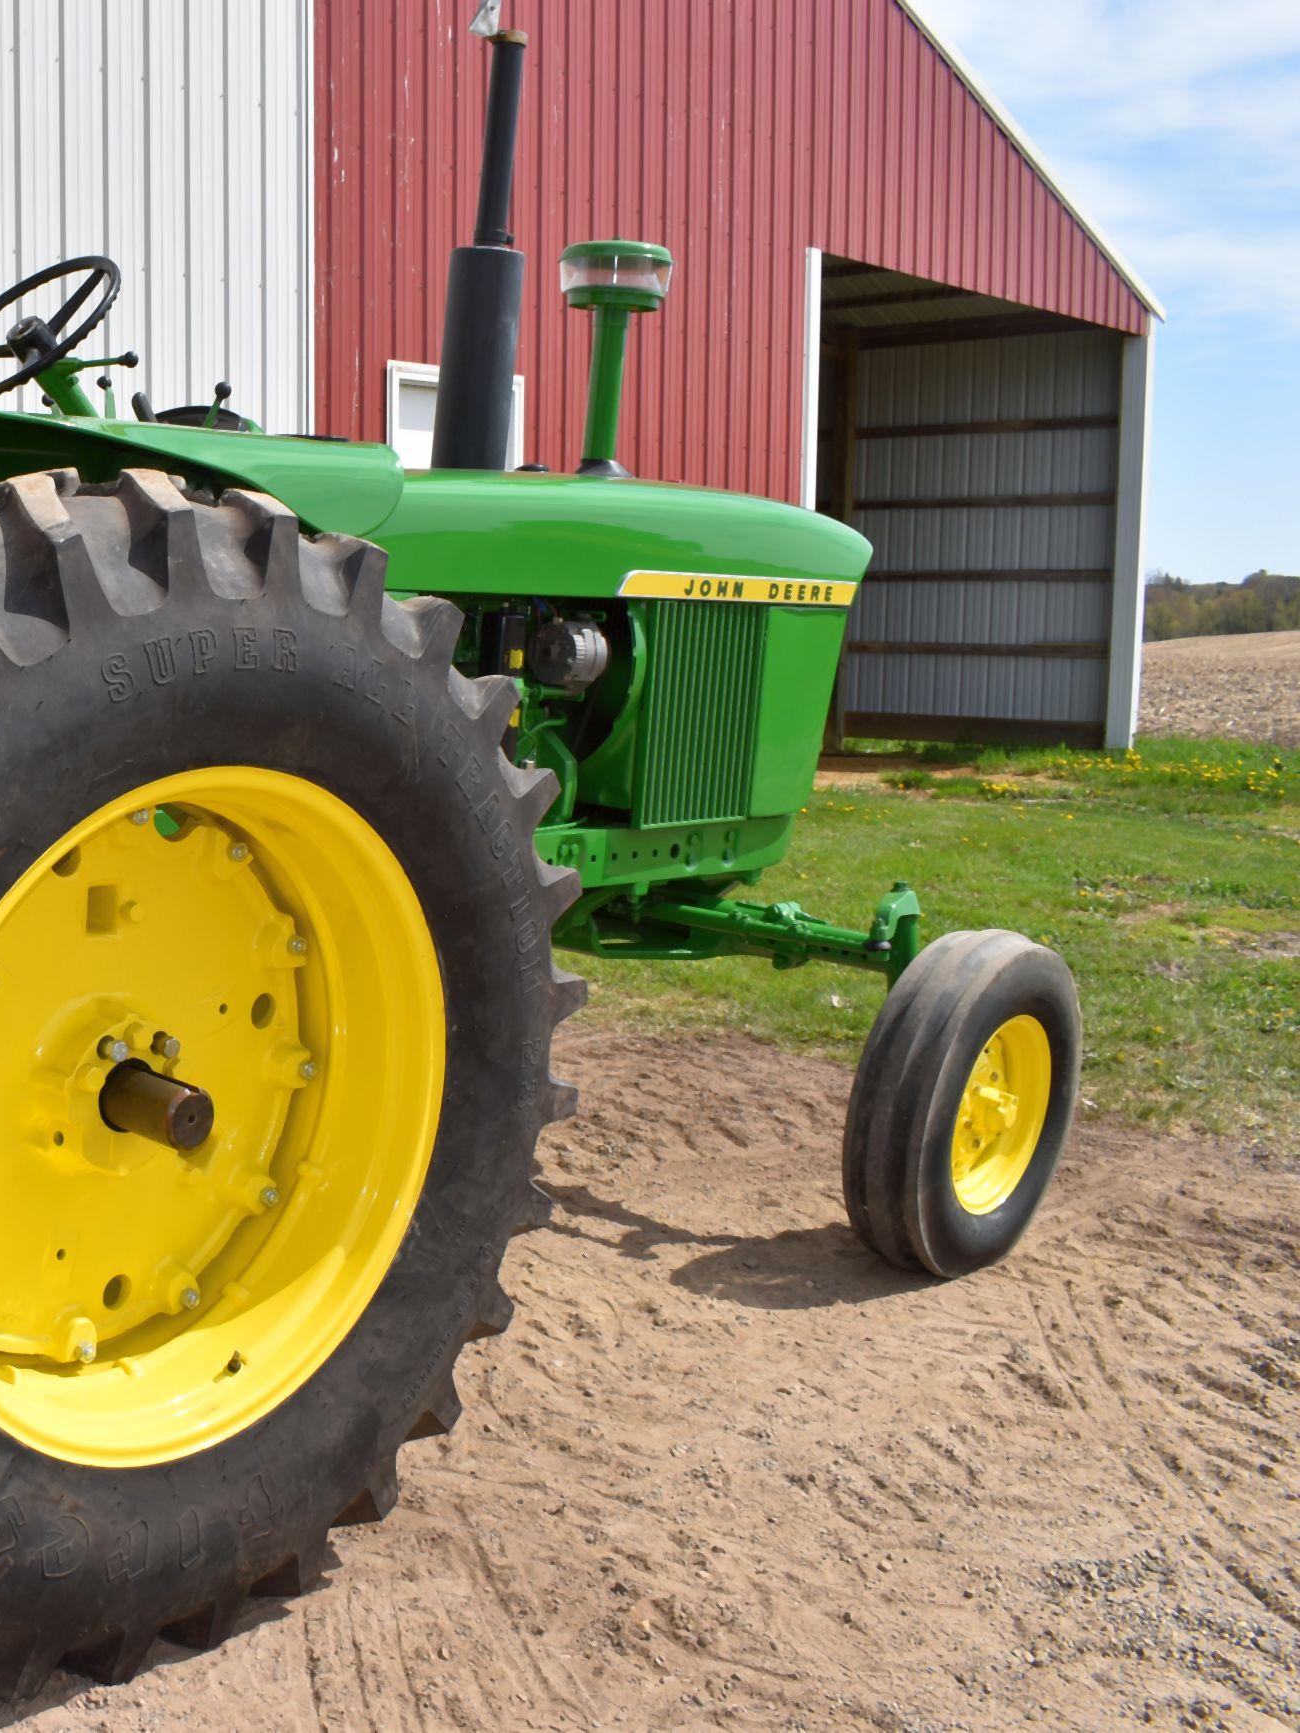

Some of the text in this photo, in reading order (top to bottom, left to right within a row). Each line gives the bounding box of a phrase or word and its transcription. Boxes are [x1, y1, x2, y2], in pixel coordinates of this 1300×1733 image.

[683, 578, 834, 602] JOHN DEERE
[101, 626, 300, 704] SUPER
